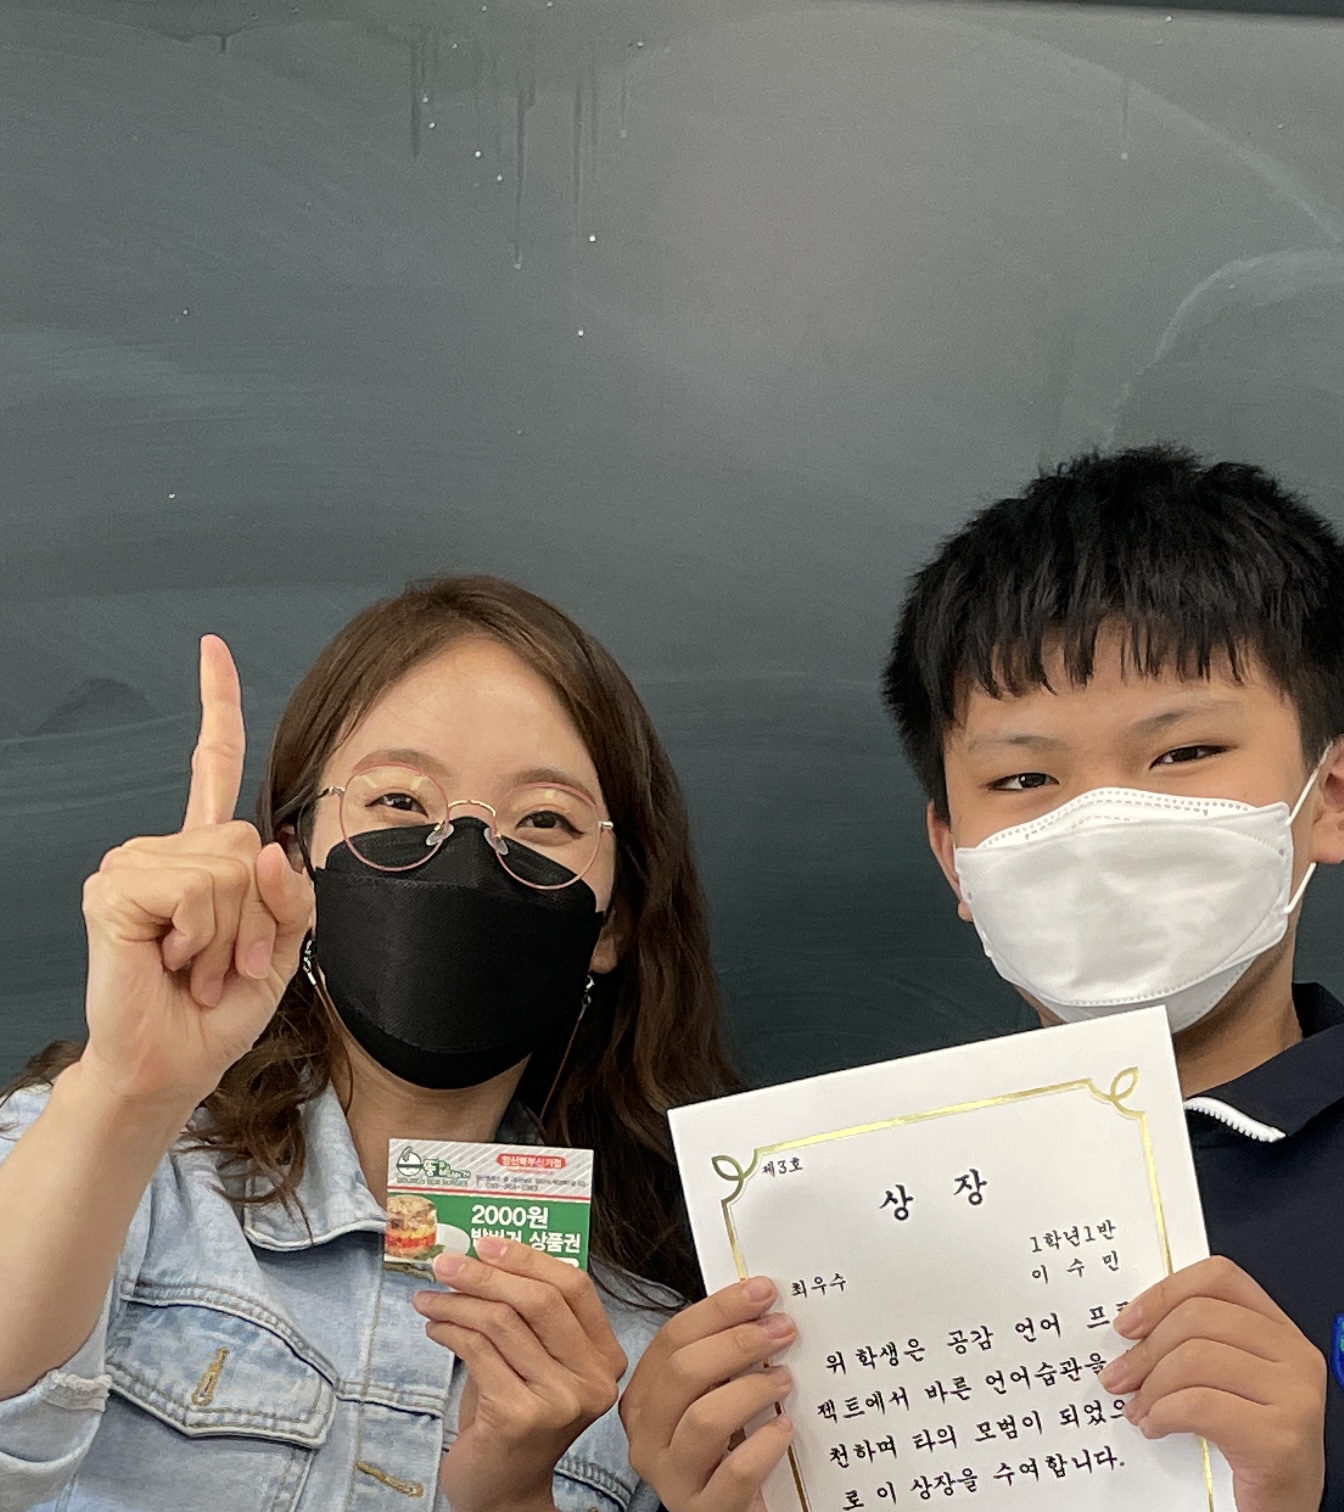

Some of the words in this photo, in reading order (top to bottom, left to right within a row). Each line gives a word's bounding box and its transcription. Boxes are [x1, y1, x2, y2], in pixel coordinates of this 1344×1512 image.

[761, 1156, 804, 1177] 제3호
[880, 1184, 914, 1221] 상
[953, 1169, 988, 1206] 장
[471, 1204, 548, 1229] 2000원
[529, 1232, 581, 1253] 상품권
[1030, 1219, 1117, 1254] 1학년1반
[790, 1272, 847, 1299] 최우수
[1032, 1264, 1049, 1286] 이
[1067, 1257, 1087, 1279] 수
[1103, 1250, 1120, 1272] 민
[825, 1351, 847, 1376] 위
[856, 1337, 926, 1370] 학생은
[946, 1325, 995, 1356] 공감
[1015, 1312, 1062, 1344] 언어
[816, 1386, 910, 1423] 젝트에서
[925, 1375, 973, 1402] 바른
[985, 1351, 1107, 1396] 언어습관을
[829, 1435, 897, 1469] 천하며
[912, 1423, 958, 1455] 타의
[974, 1410, 1044, 1443] 모범이
[842, 1489, 865, 1512] 로
[876, 1480, 897, 1505] 이
[909, 1467, 979, 1502] 상장을
[992, 1445, 1126, 1488] 수여합니다.
